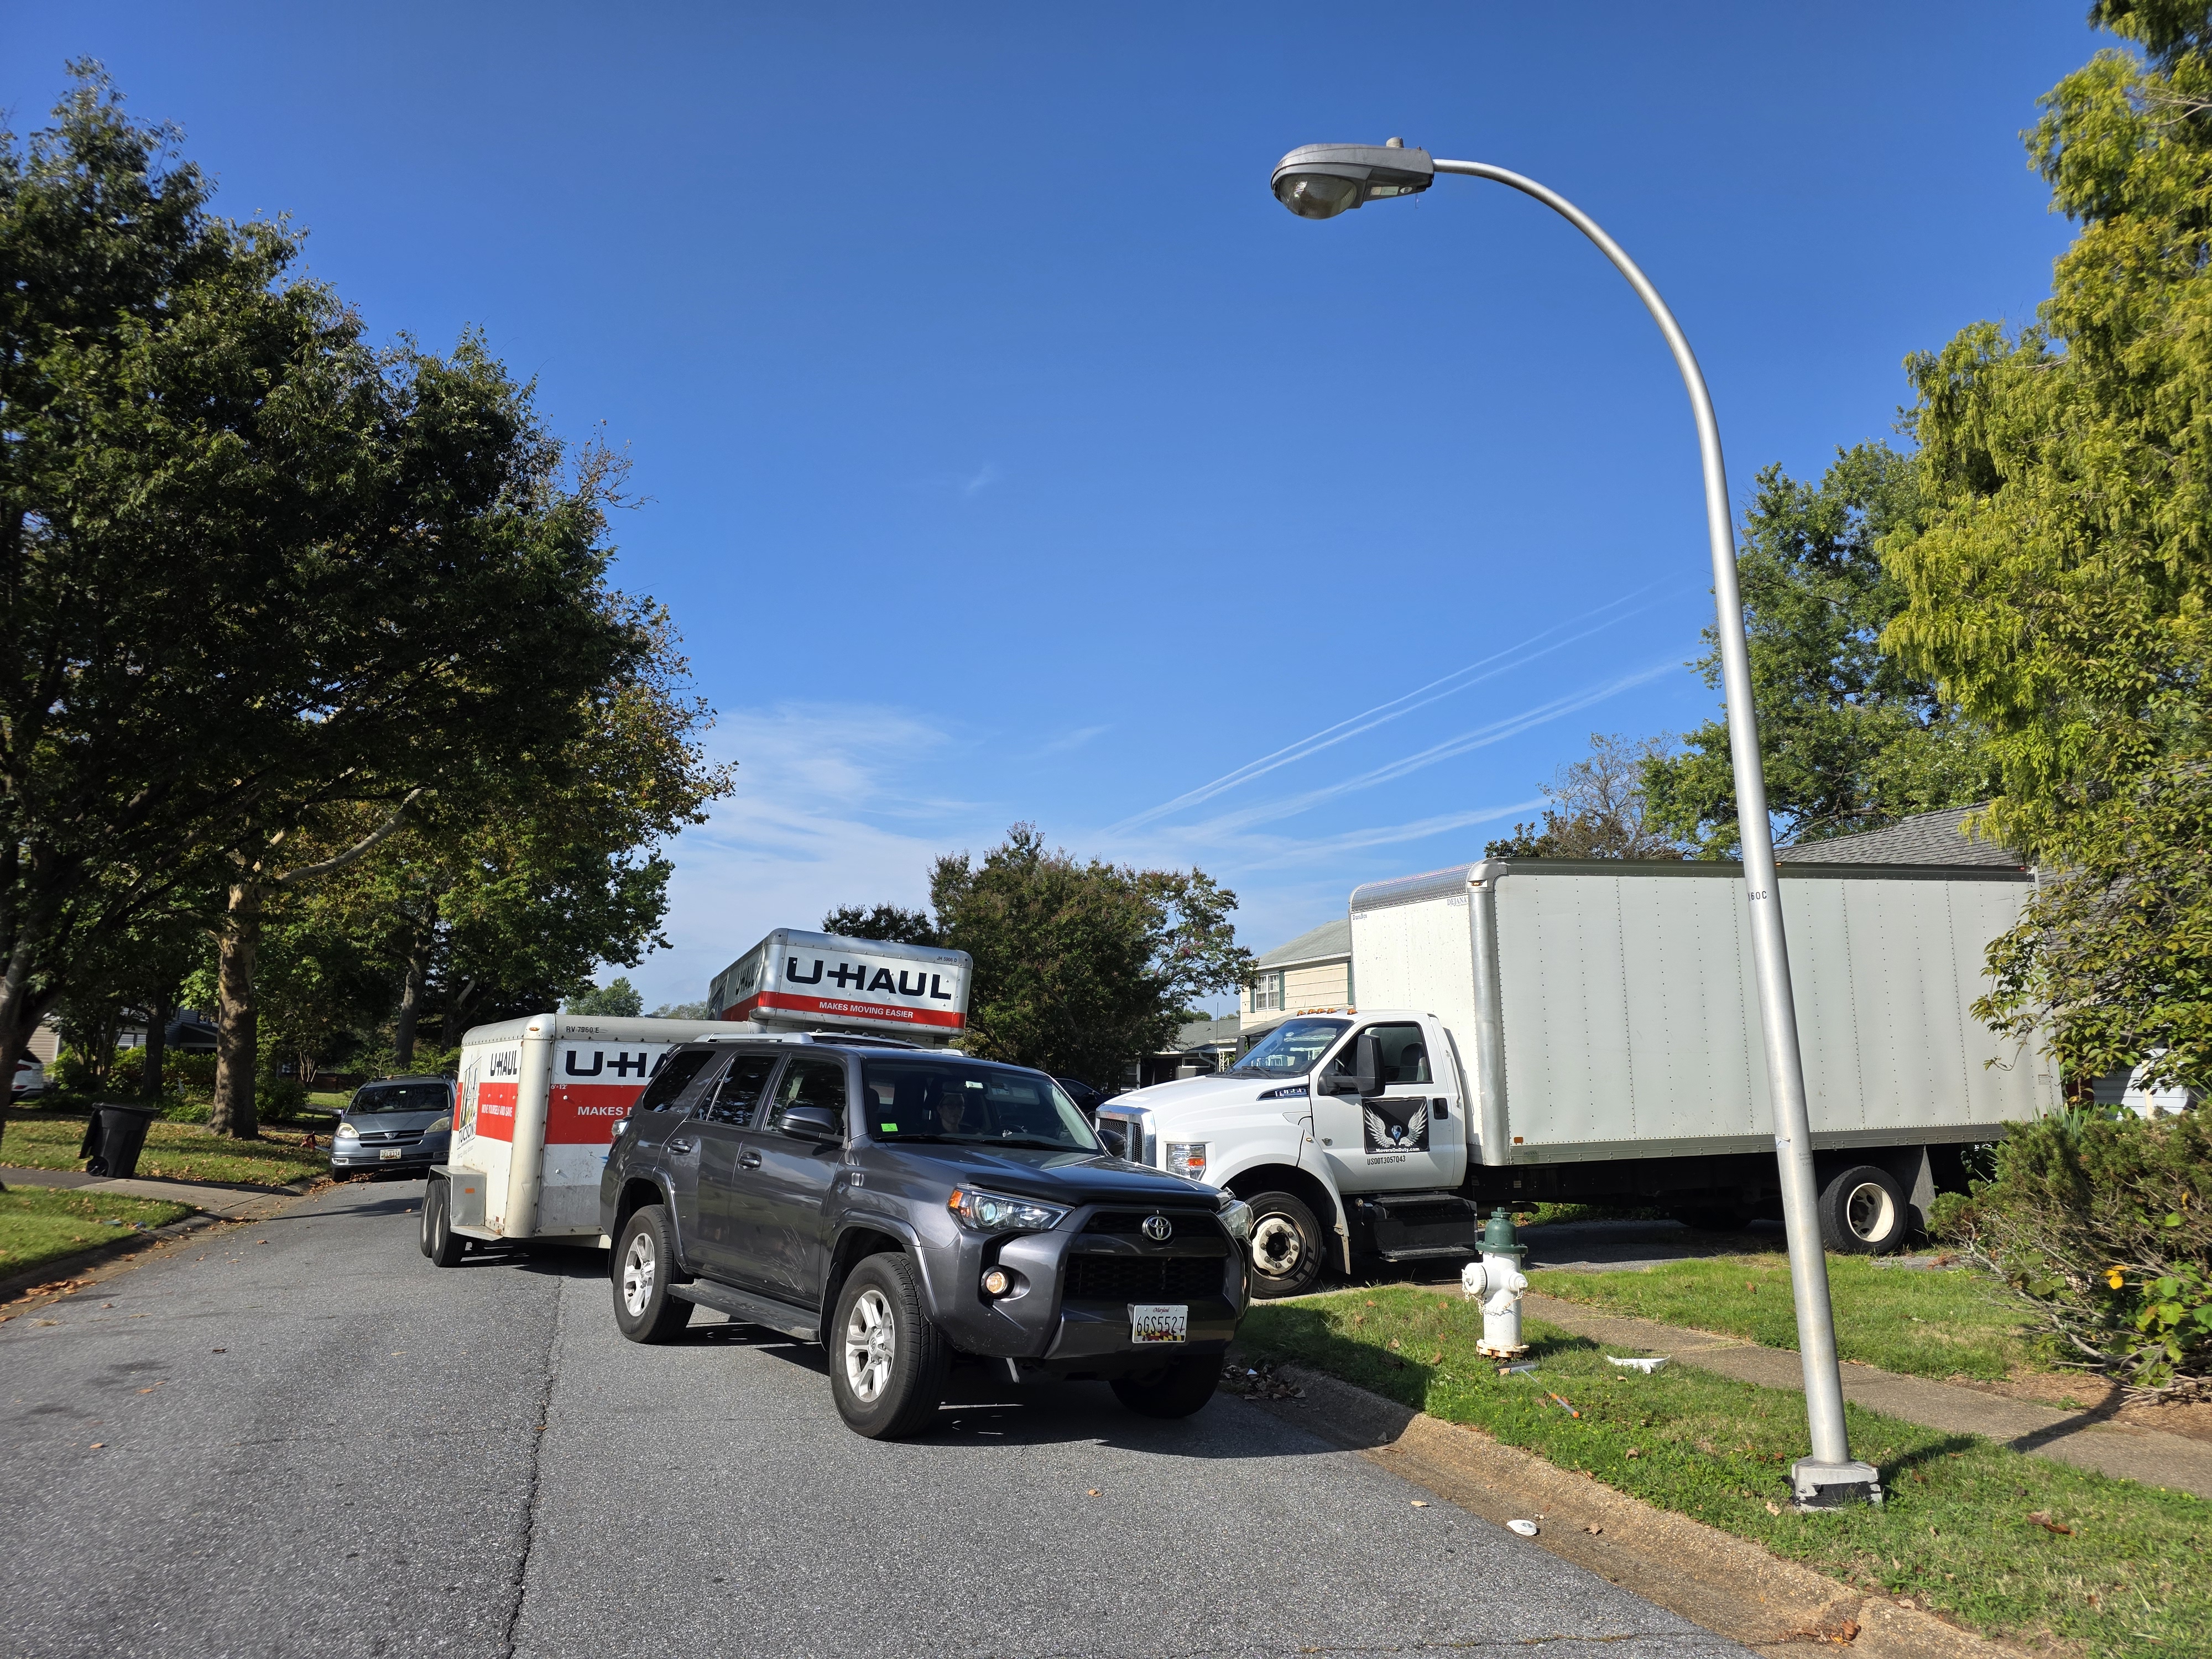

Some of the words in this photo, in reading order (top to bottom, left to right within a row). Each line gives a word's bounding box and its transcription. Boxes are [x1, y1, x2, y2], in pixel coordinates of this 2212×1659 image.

[1447, 896, 1467, 906] DEJANA
[735, 962, 756, 995] U-HAUL
[786, 957, 951, 1000] U-HAUL
[819, 1001, 849, 1011] MAKES
[850, 1004, 884, 1016] MOVING
[885, 1008, 914, 1019] EASIER
[490, 1050, 518, 1077] U-HAUL
[577, 1107, 624, 1115] MAKES
[458, 1119, 475, 1145] TUCSON
[1367, 1155, 1406, 1165] USDOT3057043
[1136, 1316, 1185, 1333] 6GS5527
